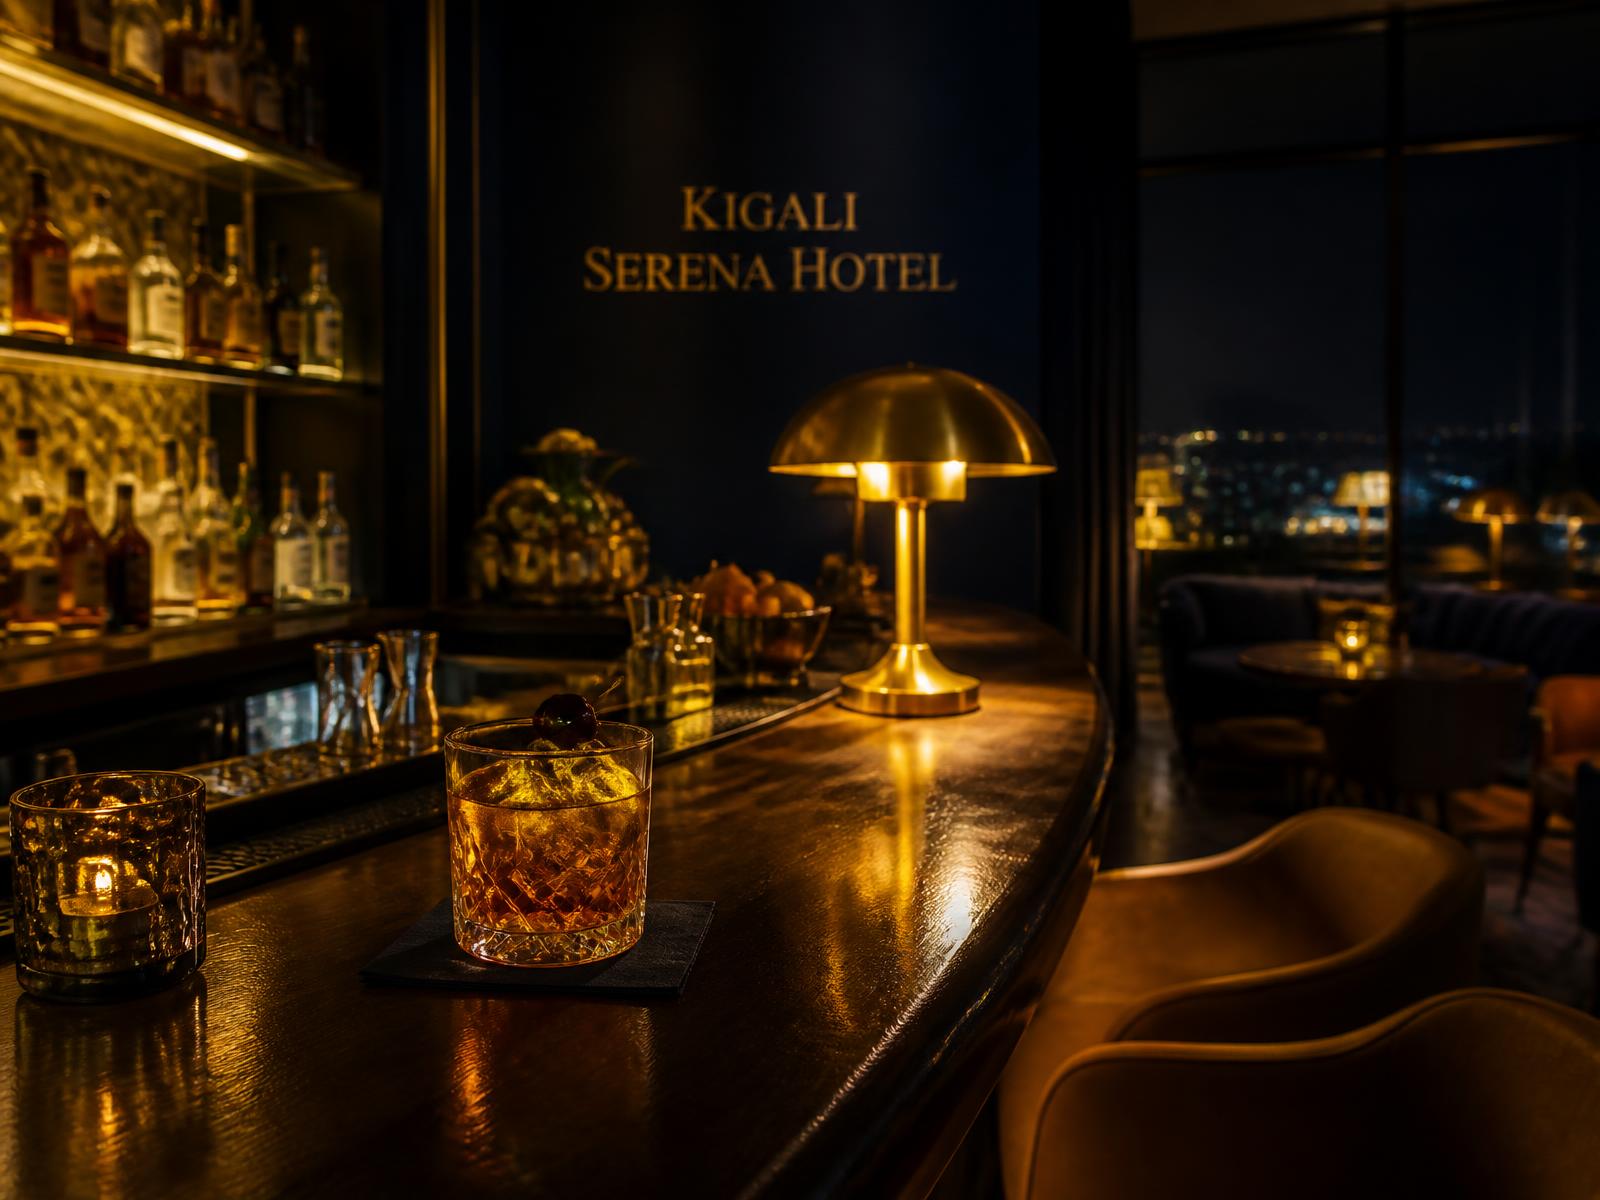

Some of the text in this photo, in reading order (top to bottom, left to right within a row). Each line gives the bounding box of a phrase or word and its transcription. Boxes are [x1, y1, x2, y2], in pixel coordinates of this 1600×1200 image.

[681, 185, 859, 232] KIGALI
[583, 246, 958, 293] SERENA HOTEL
